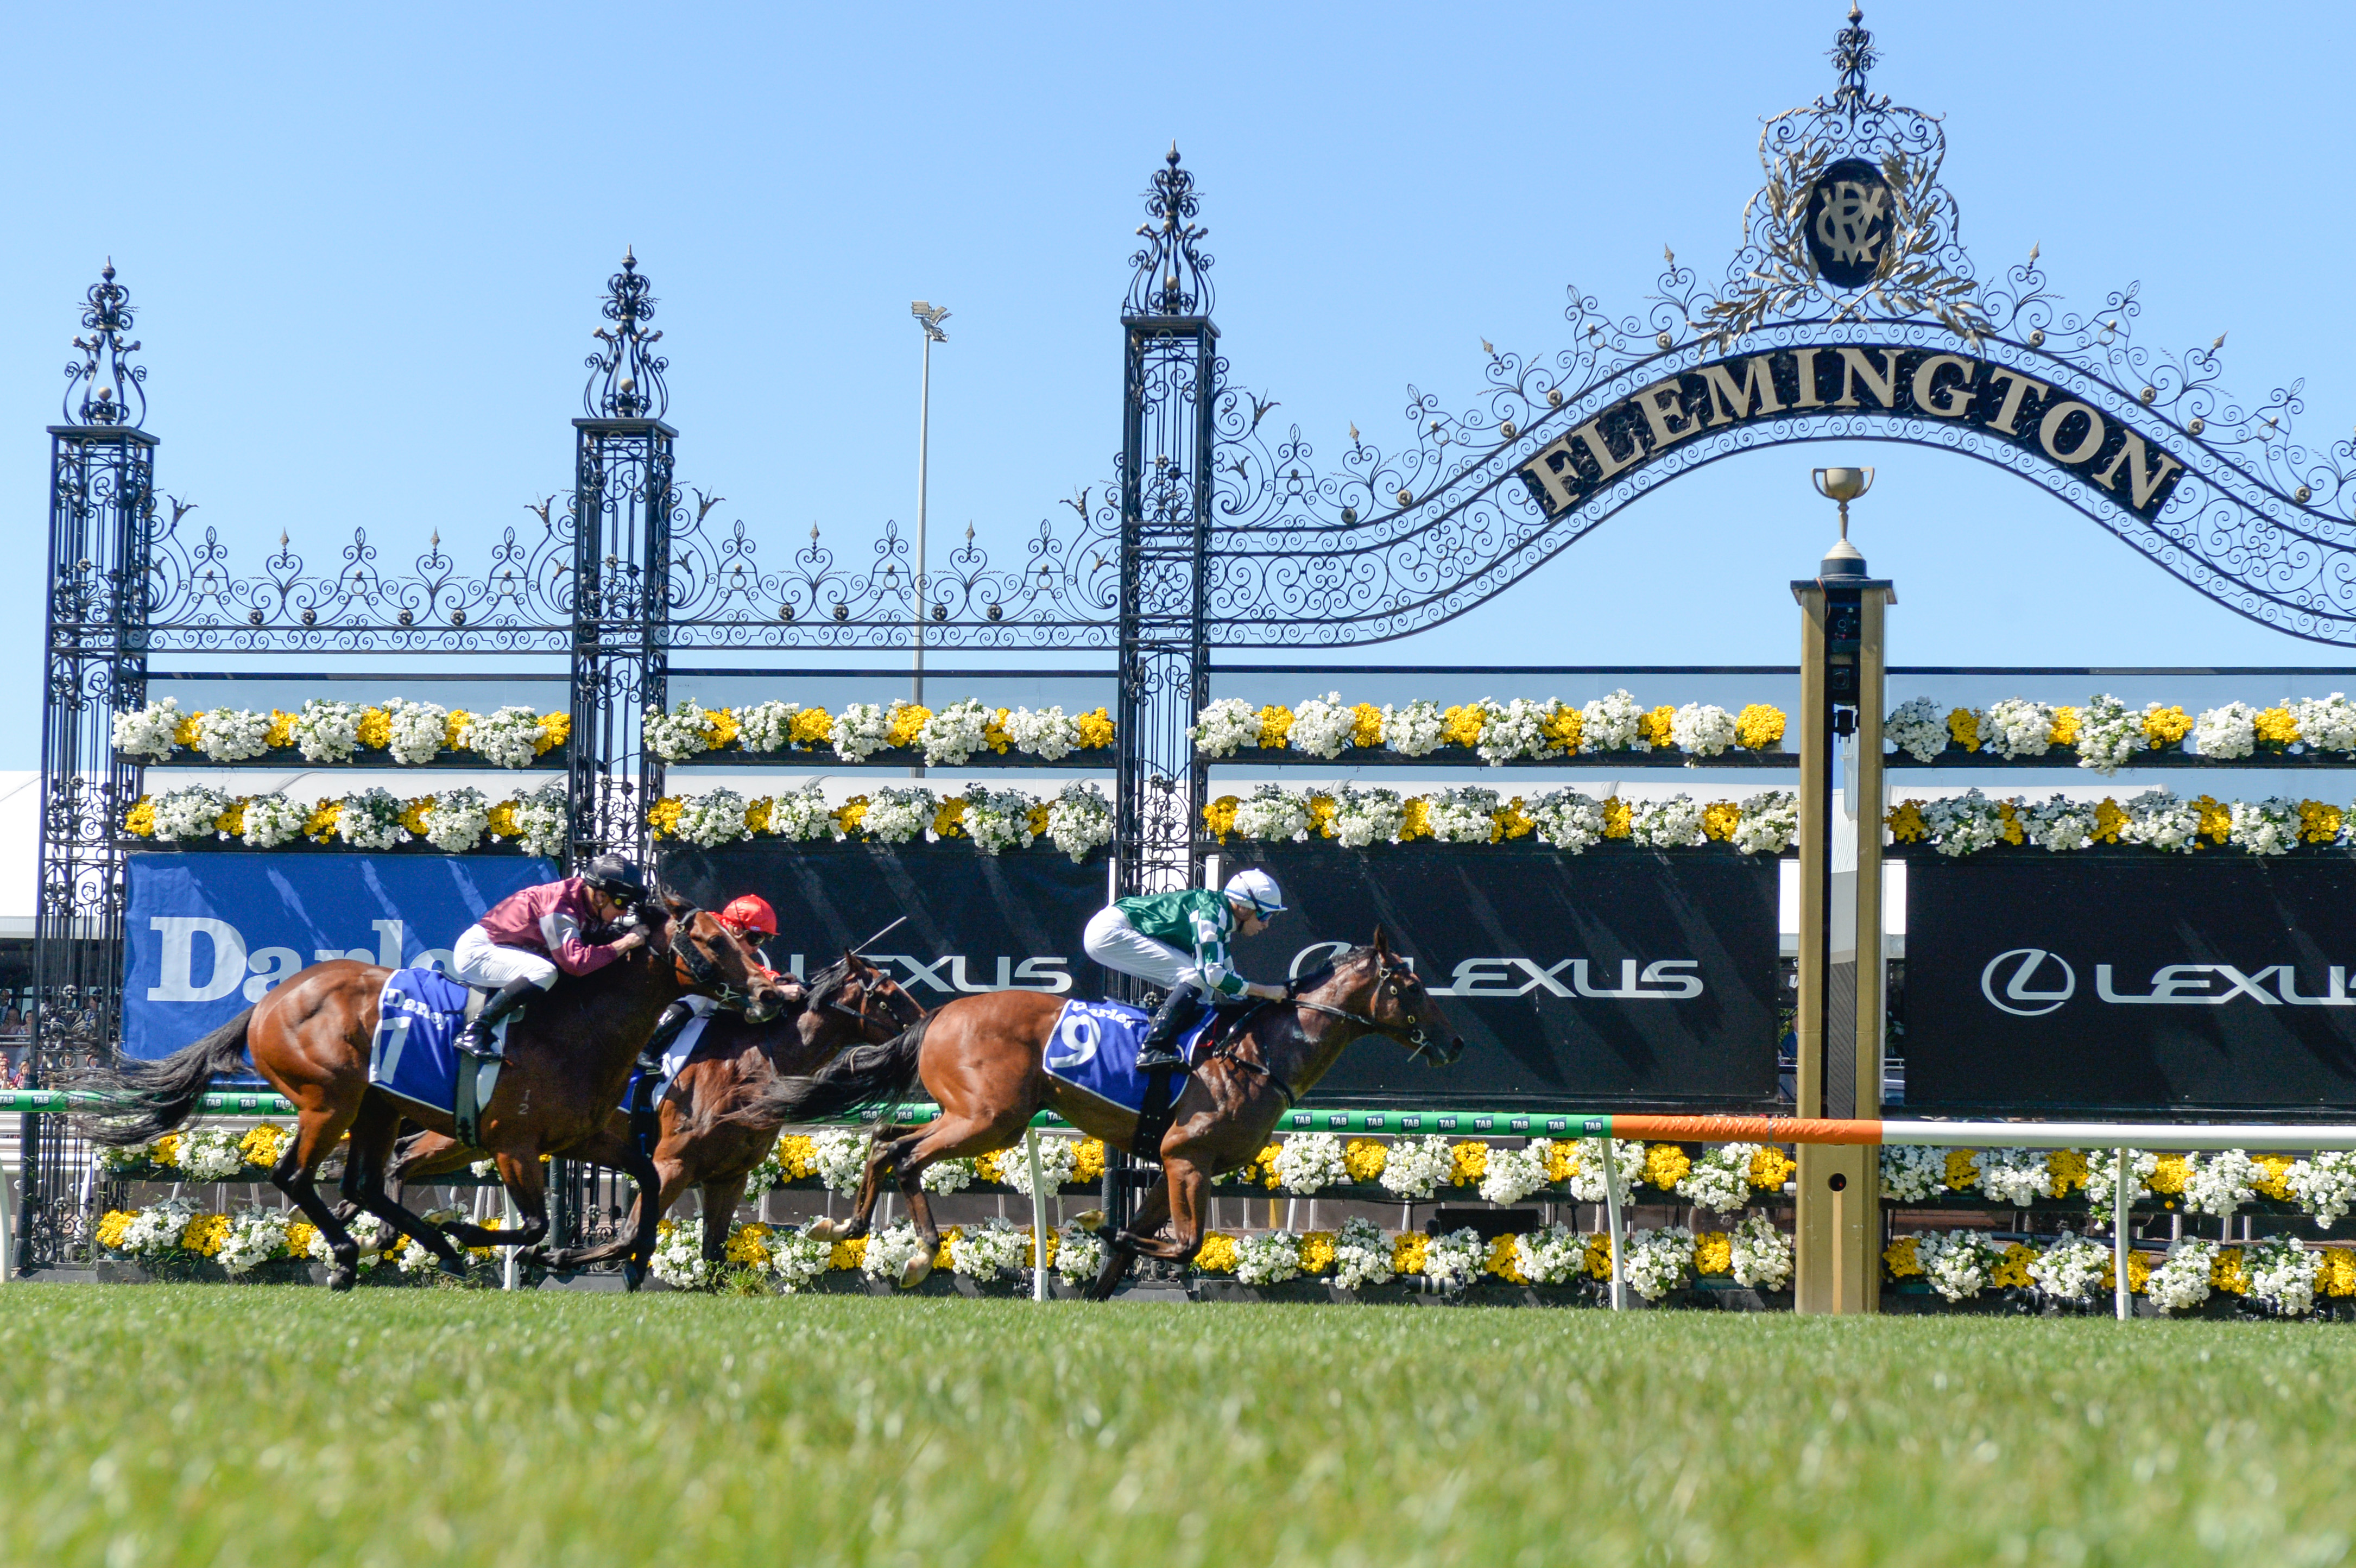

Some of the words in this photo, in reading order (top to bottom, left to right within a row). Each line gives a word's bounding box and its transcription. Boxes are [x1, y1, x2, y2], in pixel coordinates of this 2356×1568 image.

[1524, 346, 2182, 514] FLEMINGTON
[2096, 964, 2356, 1006] LEXU
[384, 988, 450, 1030] Darley
[1070, 1001, 1135, 1029] Darley
[1048, 1014, 1101, 1068] 9
[380, 1016, 412, 1085] 7
[33, 1096, 50, 1104] TAB
[206, 1098, 222, 1107] TAB
[239, 1099, 256, 1108] TAB
[274, 1099, 291, 1108] TAB
[896, 1111, 913, 1120] TAB
[932, 1112, 942, 1121] TA
[1294, 1115, 1311, 1124] TAB
[1330, 1116, 1347, 1126] TAB
[1367, 1117, 1384, 1126] TAB
[1403, 1118, 1419, 1127] TAB
[1439, 1119, 1456, 1128] TAB
[1475, 1120, 1492, 1128] TAB
[1511, 1120, 1528, 1129] TAB
[1547, 1121, 1565, 1130] TAB
[1584, 1121, 1602, 1130] TAB
